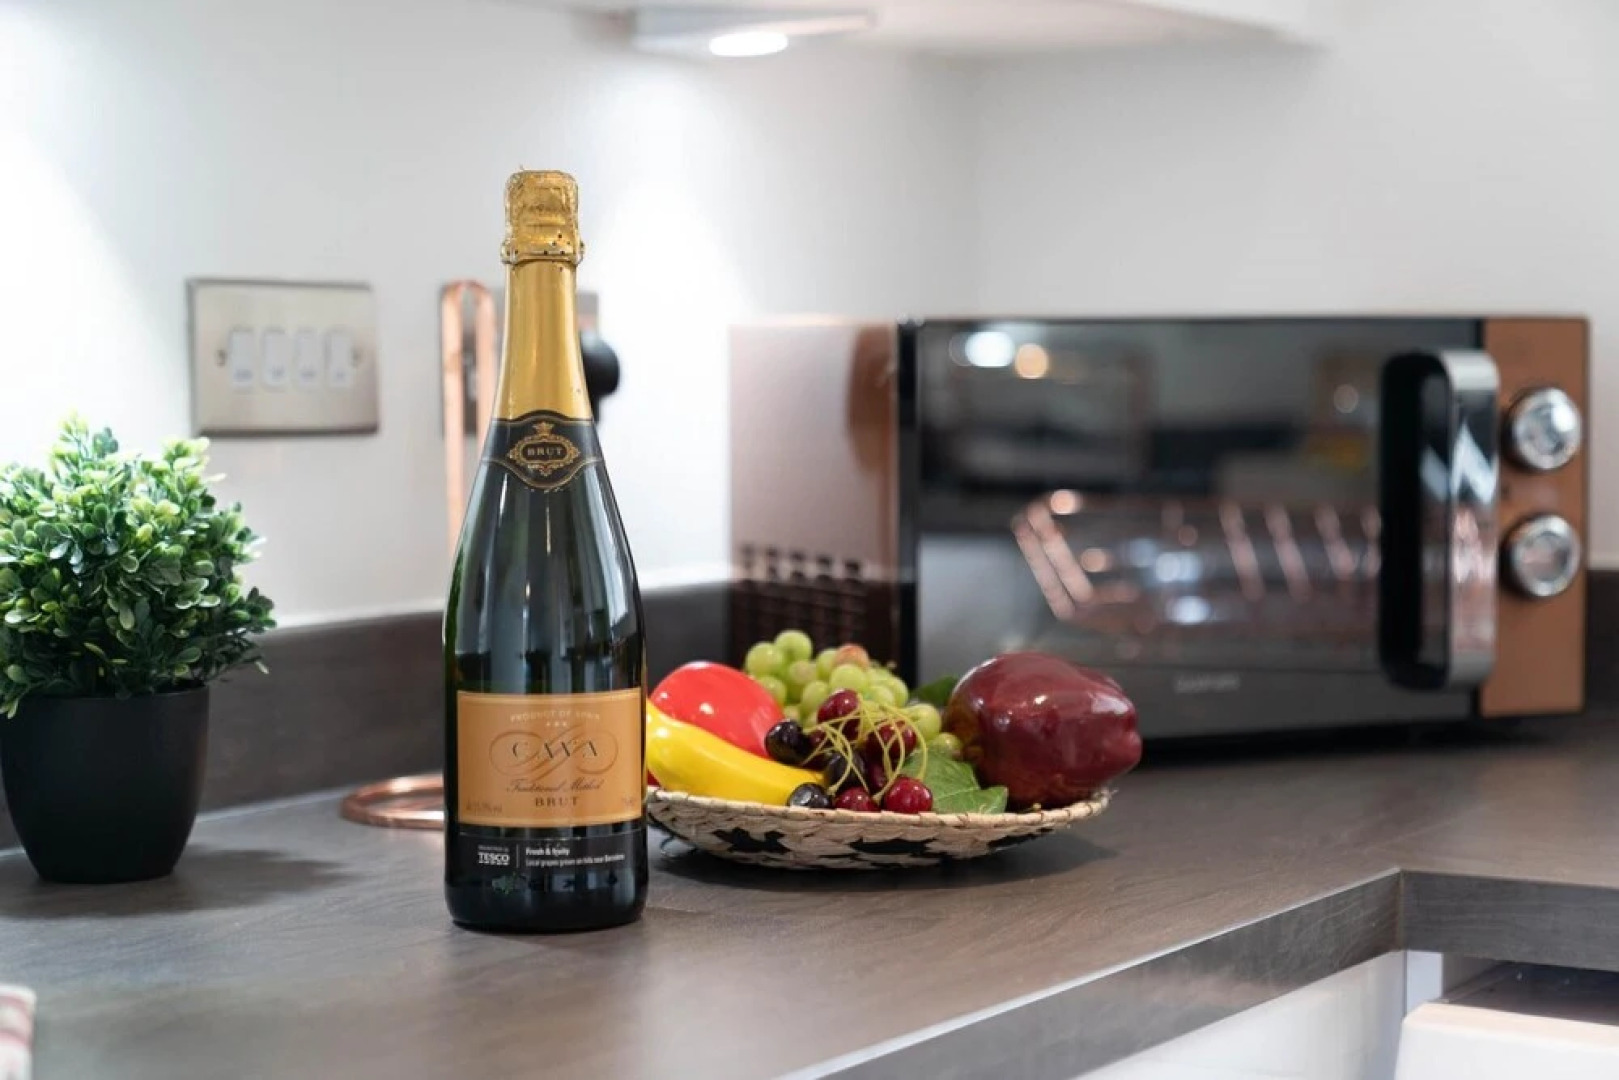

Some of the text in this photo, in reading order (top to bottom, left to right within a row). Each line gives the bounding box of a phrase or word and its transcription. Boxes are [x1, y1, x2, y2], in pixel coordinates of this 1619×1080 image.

[527, 446, 563, 456] BRUT
[510, 710, 555, 722] PRODUCT
[559, 709, 571, 718] OF
[512, 741, 598, 758] CAVA
[535, 797, 578, 807] BRUT
[478, 851, 510, 862] TESCO
[525, 847, 545, 856] Fresh
[545, 847, 552, 856] &
